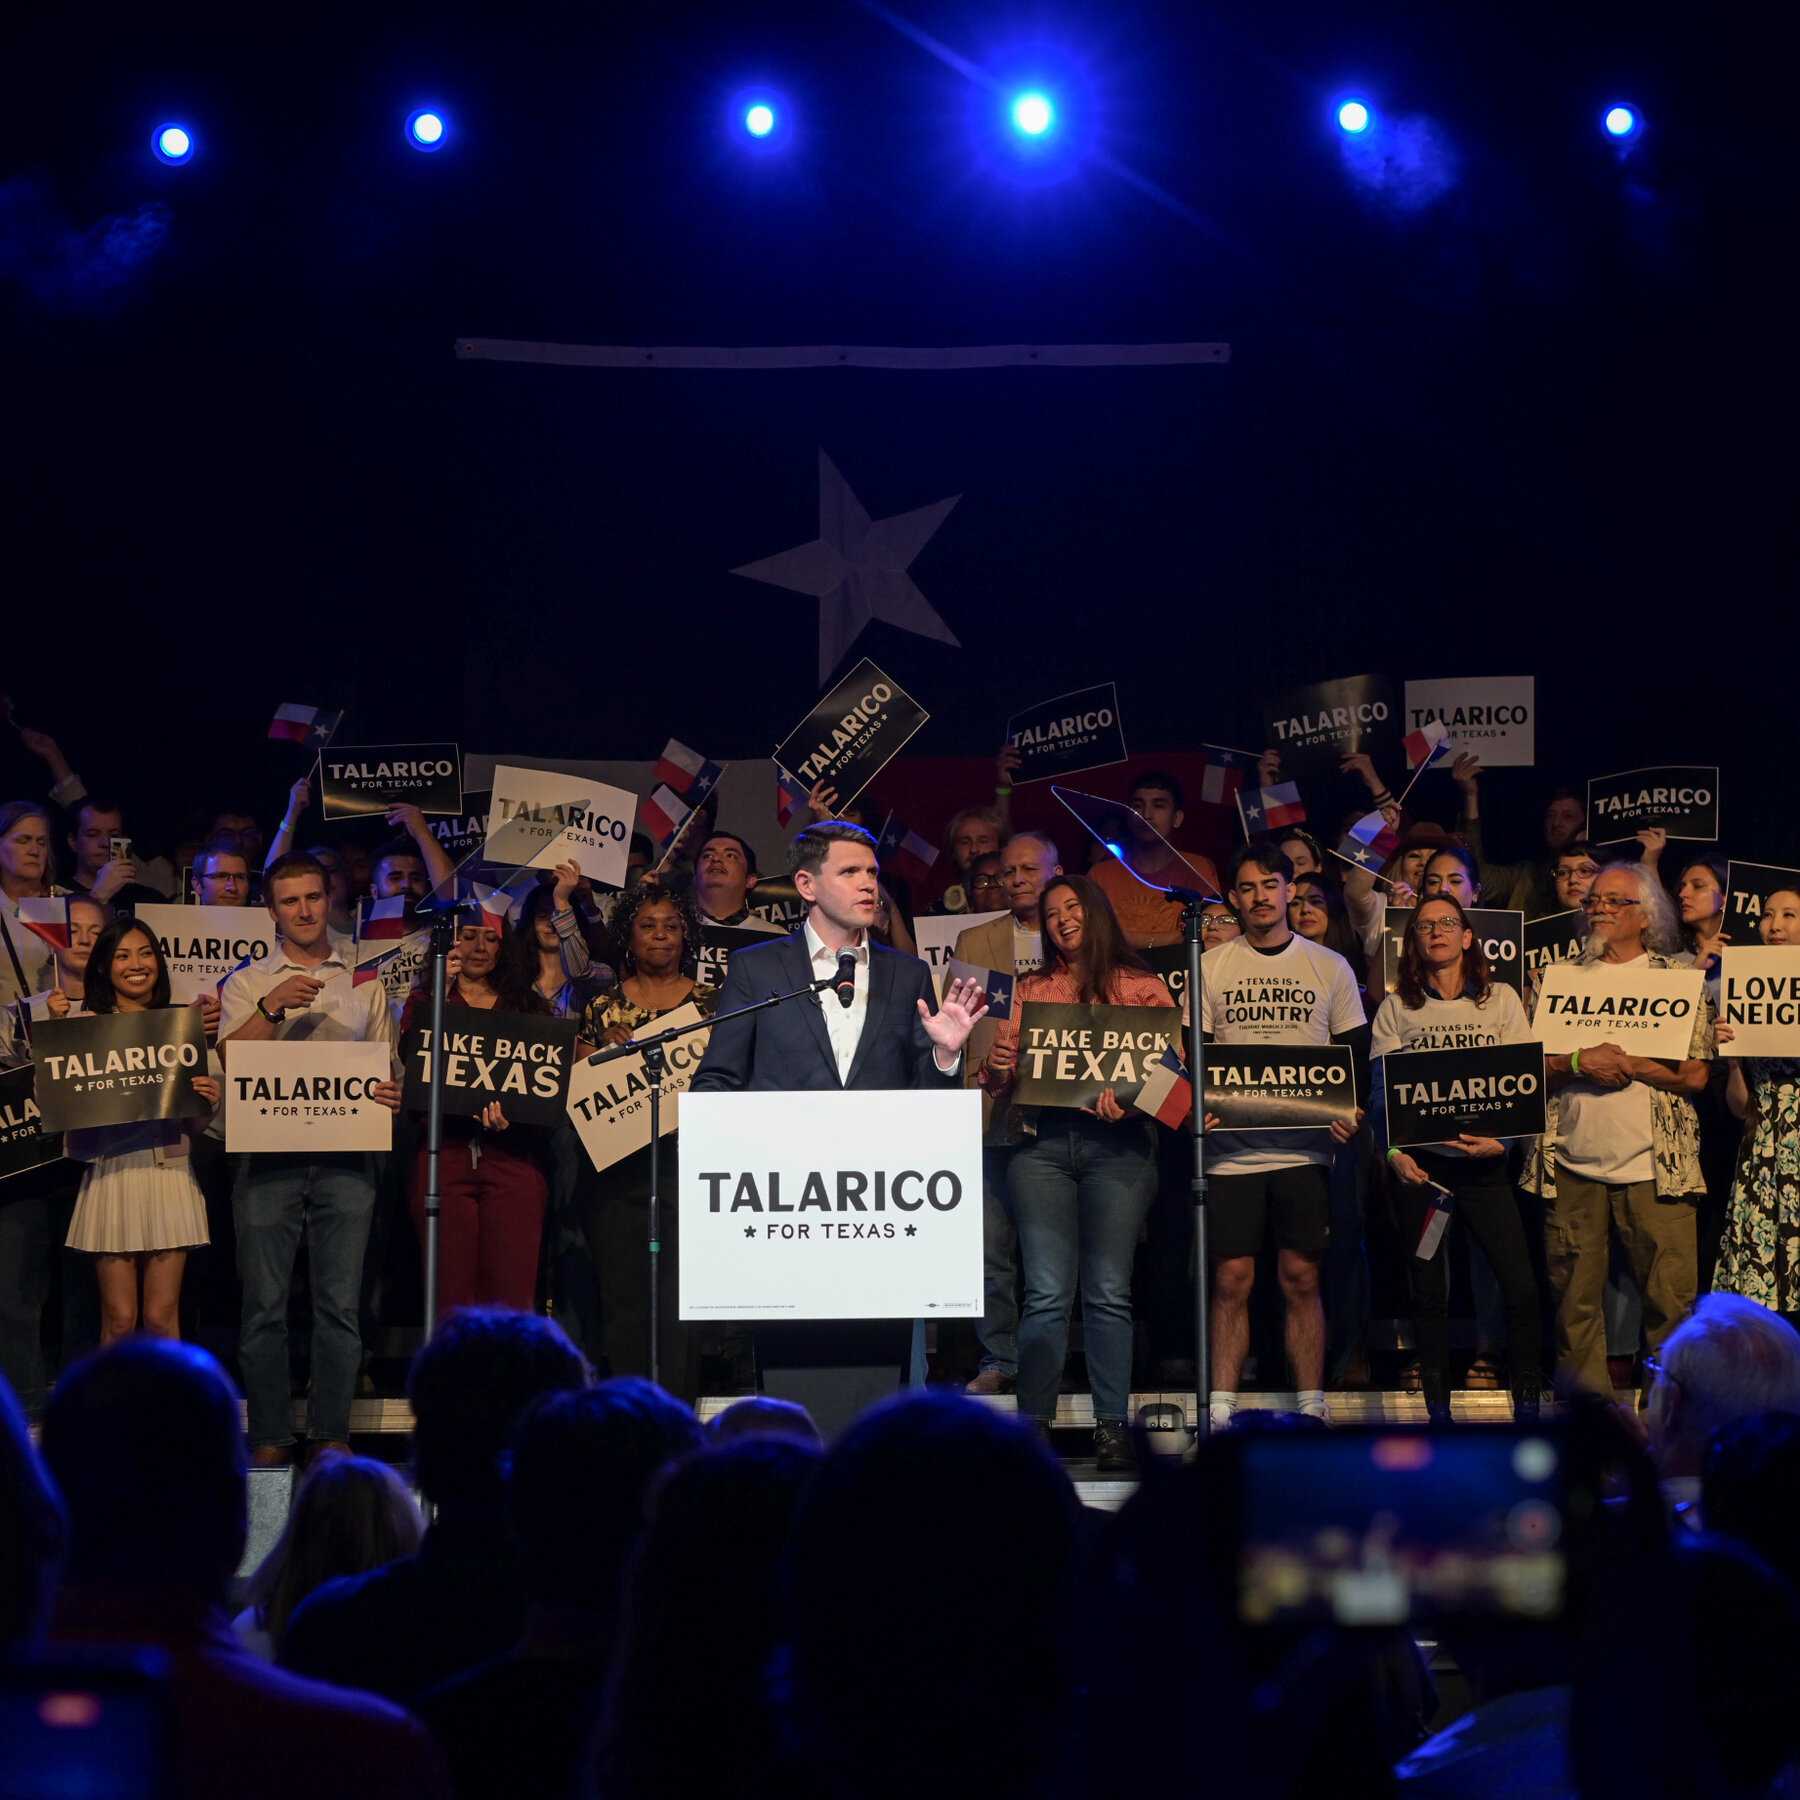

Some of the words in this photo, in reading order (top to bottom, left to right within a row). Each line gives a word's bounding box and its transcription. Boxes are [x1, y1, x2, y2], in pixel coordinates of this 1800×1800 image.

[1273, 701, 1389, 740] TALARICO
[1411, 705, 1528, 728] TALARICO
[797, 683, 892, 780] TALARICO
[1011, 708, 1113, 748] TALARICO
[1306, 734, 1326, 746] FOR
[1329, 727, 1364, 740] TEXAS
[1463, 729, 1497, 738] TEXAS
[836, 749, 855, 769] FOR
[853, 720, 882, 750] TEXAS
[1036, 743, 1055, 754] FOR
[1058, 735, 1089, 749] TEXAS
[328, 760, 454, 780] TALARICO
[361, 781, 383, 789] FOR
[387, 779, 423, 788] TEXAS
[1594, 787, 1711, 815] TALARICO
[498, 798, 626, 841] TALARICO
[1622, 807, 1642, 819] FOR
[1646, 806, 1681, 814] TEXAS
[427, 814, 490, 840] TALA
[530, 827, 553, 837] FOR
[453, 838, 473, 848] FOR
[755, 901, 810, 923] TALA
[158, 937, 268, 961] ALARICO
[1525, 936, 1588, 969] TALA
[173, 964, 194, 973] FOR
[200, 964, 234, 974] TEXAS
[1246, 977, 1279, 986] TEXAS
[1727, 977, 1800, 1000] LOVE
[1222, 988, 1316, 1006] TALARICO
[1546, 995, 1690, 1018] TALARICO
[1225, 1006, 1313, 1024] COUNTRY
[1576, 1019, 1601, 1028] FOR
[1607, 1020, 1648, 1029] TEXAS
[1727, 1003, 1800, 1025] NEIG
[1428, 1024, 1461, 1032] TEXAS
[1028, 1028, 1093, 1049] TAKE
[1102, 1030, 1170, 1051] BACK
[44, 1043, 199, 1080] TALARICO
[494, 1038, 563, 1066] BACK
[416, 1050, 561, 1098] TEXAS
[1026, 1048, 1165, 1083] TEXAS
[1207, 1065, 1347, 1086] TALARICO
[88, 1077, 115, 1092] FOR
[119, 1073, 164, 1087] TEXAS
[234, 1077, 382, 1101] TALARICO
[1244, 1089, 1268, 1097] FOR
[1272, 1088, 1312, 1097] TEXAS
[1393, 1073, 1538, 1105] TALARICO
[619, 1100, 643, 1119] FOR
[645, 1078, 685, 1102] TXAS
[1431, 1106, 1456, 1116] FOR
[1460, 1102, 1502, 1112] TEXAS
[273, 1107, 298, 1116] FOR
[304, 1107, 346, 1116] TEXAS
[12, 1125, 37, 1140] FOR
[698, 1169, 963, 1213] TALARICO
[767, 1223, 811, 1239] FOR
[821, 1223, 896, 1239] TEXAS
